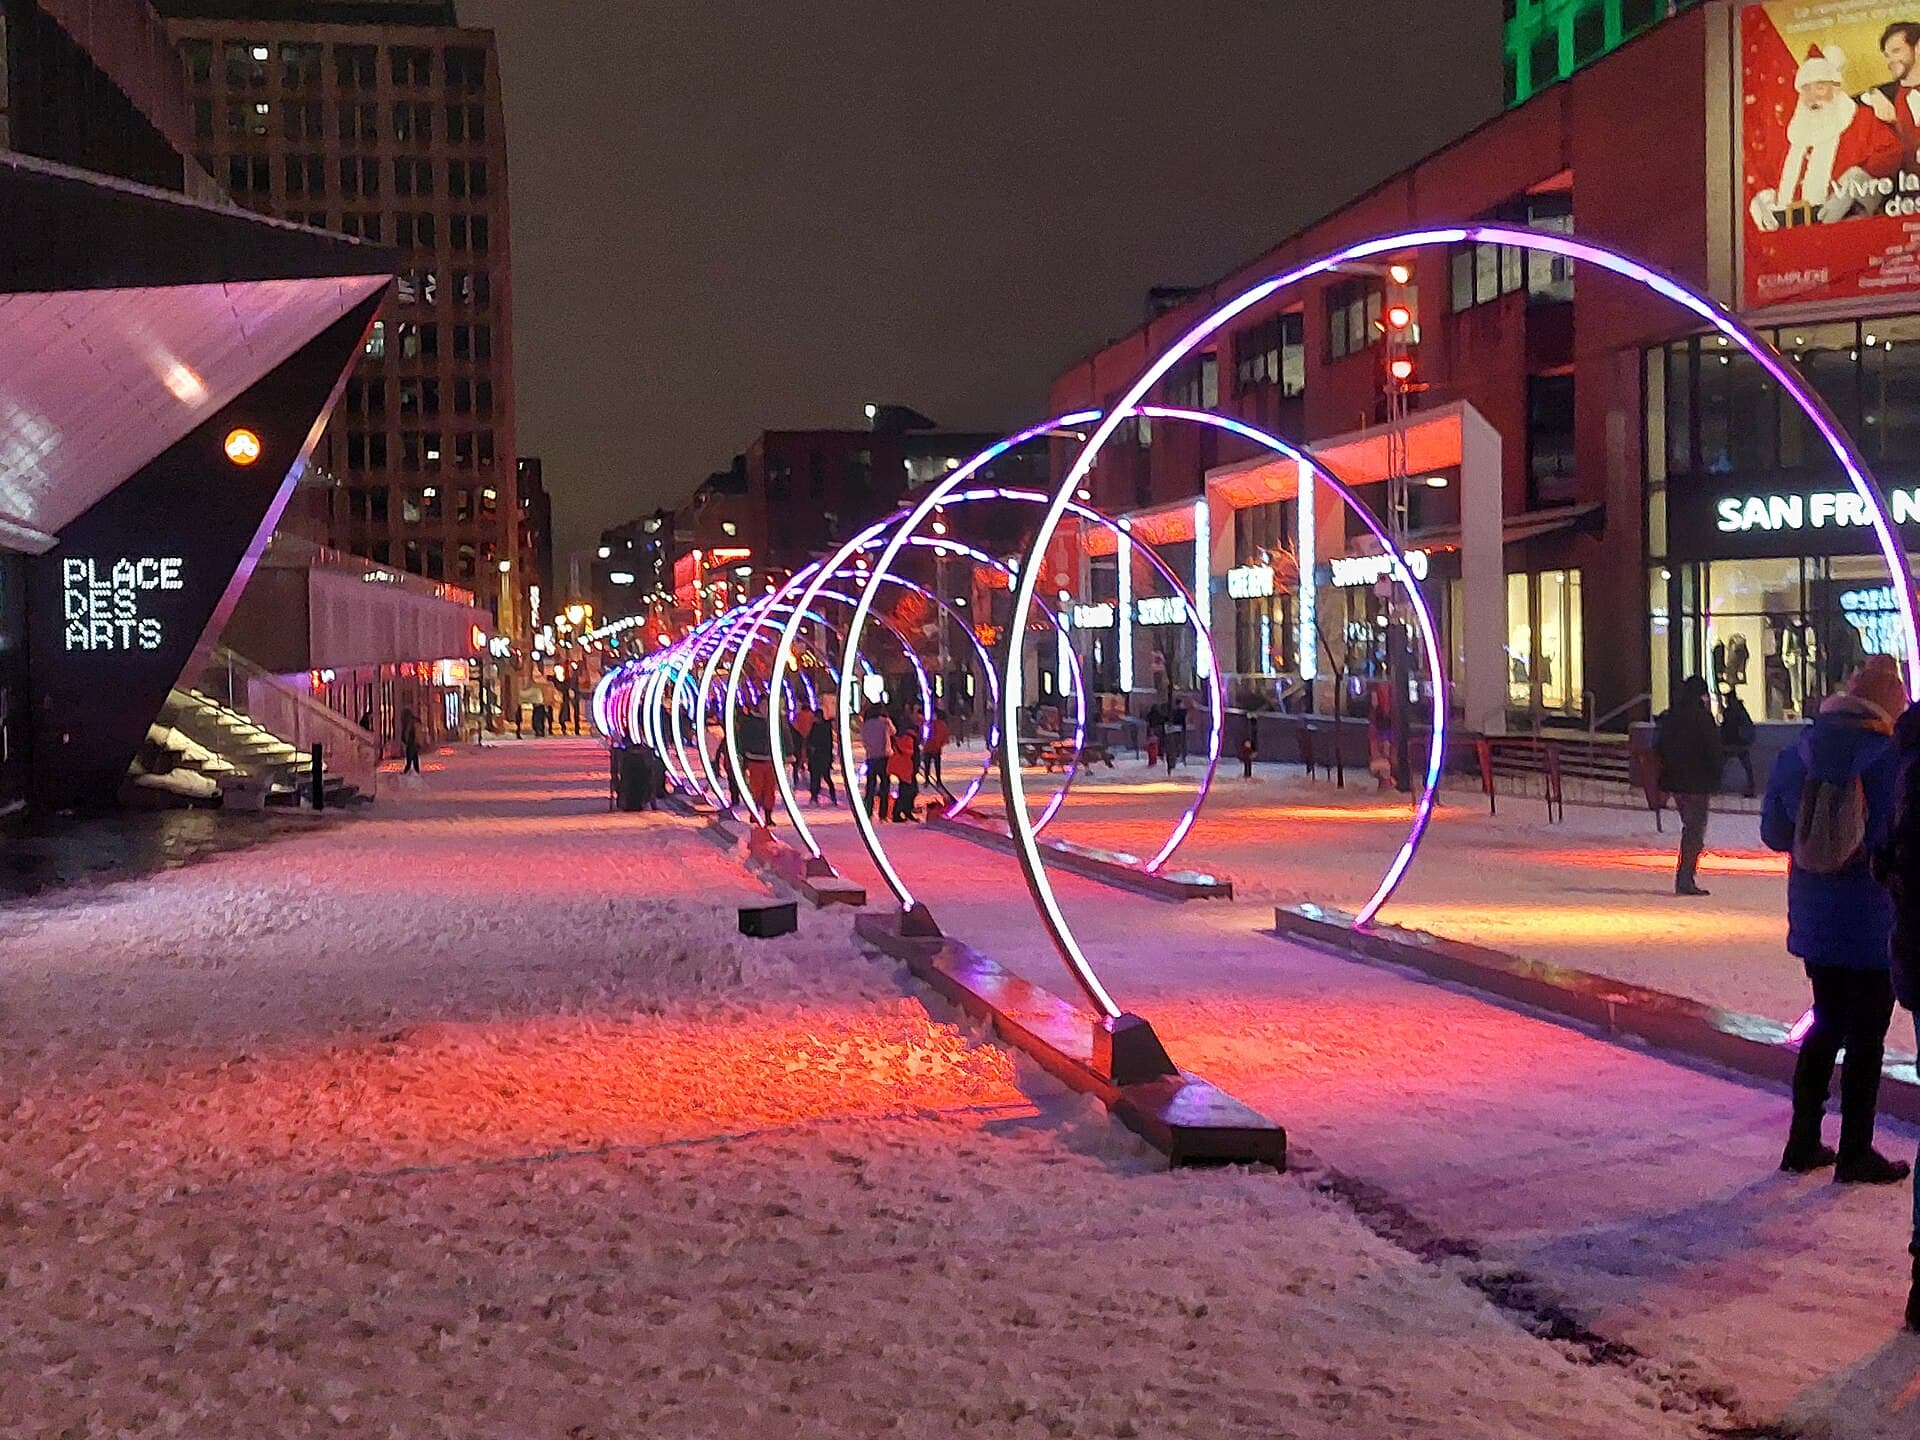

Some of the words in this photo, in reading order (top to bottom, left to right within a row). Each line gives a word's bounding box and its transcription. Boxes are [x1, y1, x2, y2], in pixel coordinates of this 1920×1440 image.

[1717, 494, 1803, 532] SAN
[63, 557, 183, 590] PLACE
[64, 588, 137, 620] DES
[65, 618, 162, 650] ARTS
